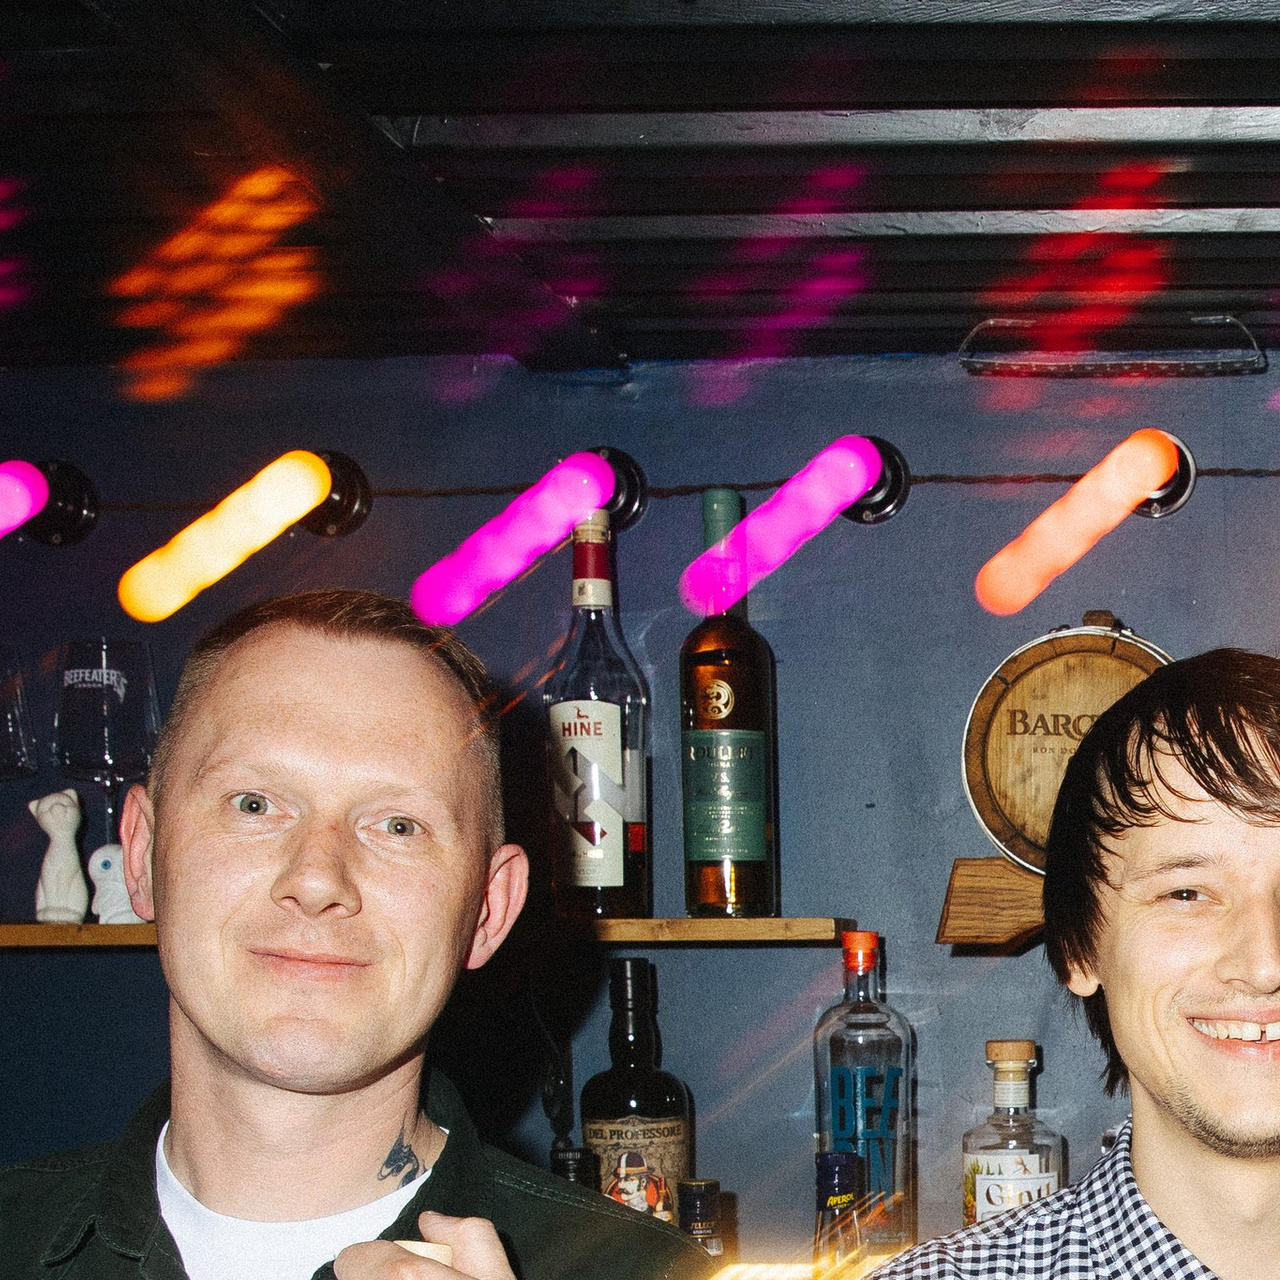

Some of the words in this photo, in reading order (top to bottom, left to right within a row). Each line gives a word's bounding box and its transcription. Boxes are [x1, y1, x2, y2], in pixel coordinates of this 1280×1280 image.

[561, 721, 603, 738] HINE
[589, 1127, 607, 1140] DEL
[609, 1125, 682, 1140] PROFESSORE
